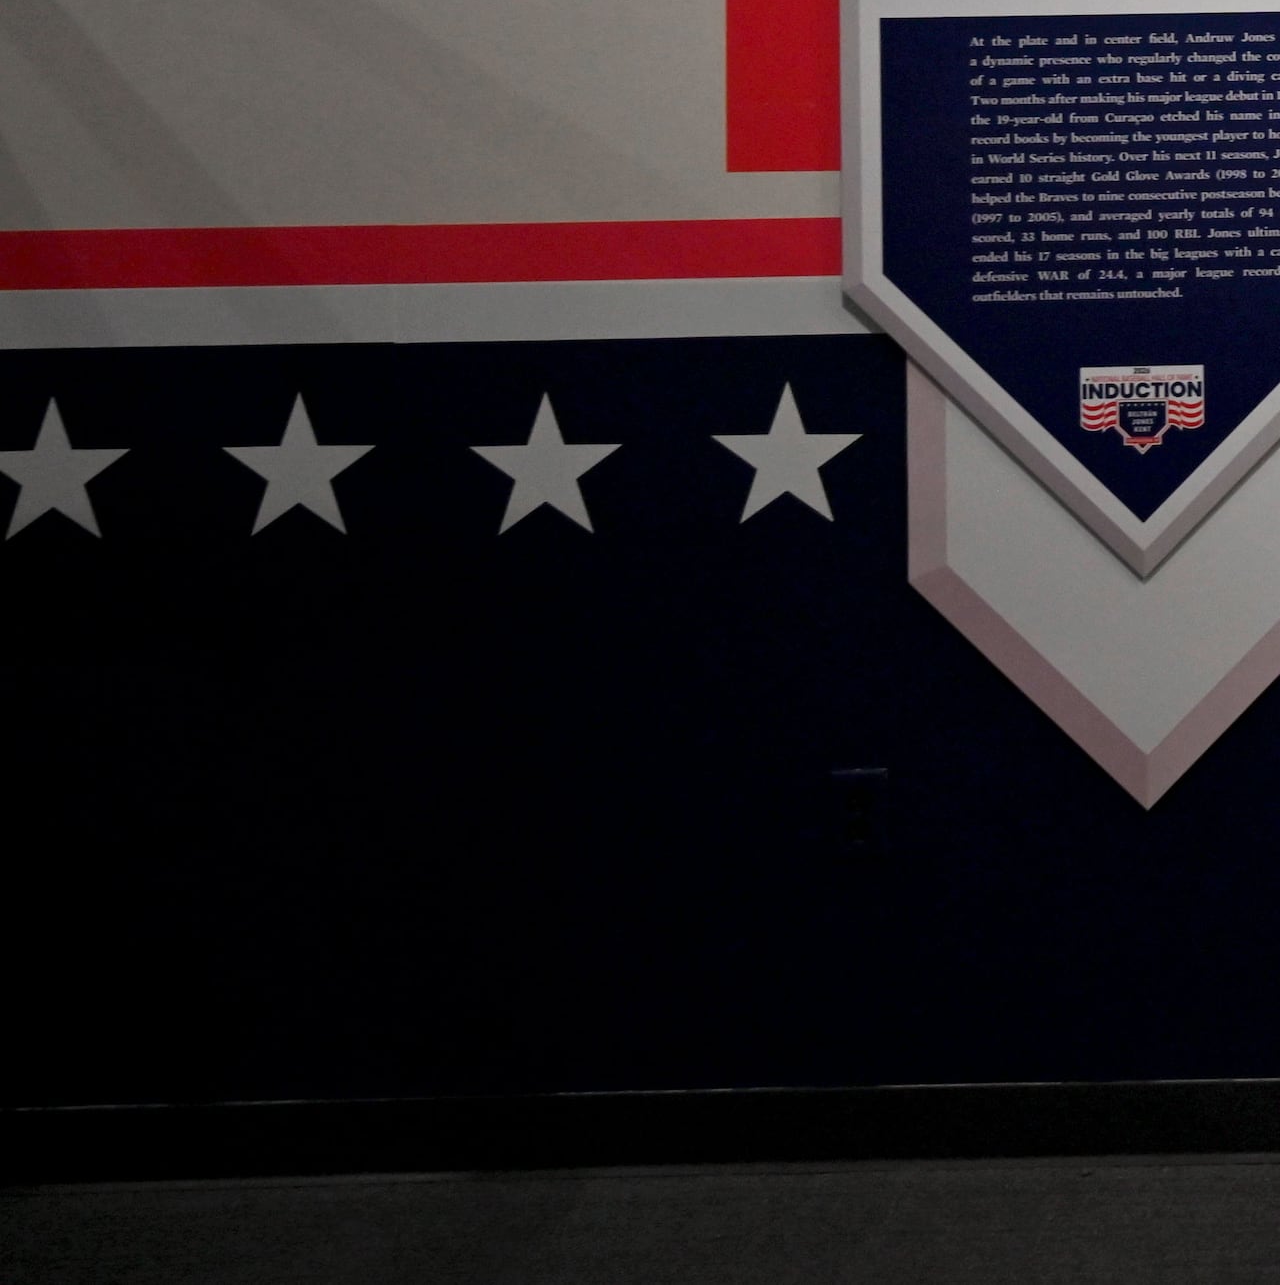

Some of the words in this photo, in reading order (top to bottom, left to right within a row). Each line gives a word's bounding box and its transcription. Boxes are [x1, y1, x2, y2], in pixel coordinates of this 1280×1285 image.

[970, 37, 984, 46] At
[991, 35, 1011, 46] the
[1018, 34, 1048, 48] plate
[1055, 34, 1077, 45] and
[1103, 35, 1142, 44] center
[1148, 32, 1178, 44] field,
[1185, 31, 1234, 43] Andruw
[1240, 31, 1275, 42] Jones
[970, 58, 976, 66] a
[982, 54, 1034, 66] dynamic
[1039, 57, 1092, 68] presence
[1096, 53, 1122, 64] who
[1128, 52, 1182, 66] regularly
[1186, 51, 1236, 65] changed
[1241, 50, 1261, 61] the
[970, 74, 984, 85] of
[1003, 77, 1035, 90] game
[1042, 73, 1070, 84] with
[1076, 76, 1091, 84] an
[1098, 75, 1130, 83] extra
[1136, 71, 1163, 83] base
[1170, 71, 1186, 82] hit
[1193, 74, 1207, 82] or
[1226, 70, 1265, 84] diving
[970, 95, 998, 105] Two
[1000, 93, 1046, 105] months
[1048, 92, 1078, 104] after
[1080, 92, 1125, 106] making
[1127, 91, 1145, 102] his
[1147, 94, 1182, 107] major
[1184, 90, 1223, 104] league
[1224, 89, 1259, 101] debut
[1261, 92, 1274, 100] in
[970, 114, 990, 125] the
[1069, 112, 1098, 123] from
[1160, 110, 1200, 121] etched
[1206, 109, 1224, 120] his
[1230, 112, 1262, 120] name
[971, 133, 1010, 144] record
[1014, 132, 1049, 143] books
[1052, 132, 1067, 145] by
[1070, 131, 1129, 145] becoming
[1132, 130, 1152, 141] the
[1155, 132, 1208, 146] youngest
[1212, 129, 1249, 143] player
[1252, 131, 1265, 139] to
[971, 156, 983, 164] in
[987, 152, 1025, 163] World
[1028, 152, 1066, 163] Series
[1069, 151, 1115, 164] history.
[1118, 151, 1149, 161] Over
[1152, 150, 1170, 160] his
[1174, 152, 1201, 160] next
[1220, 151, 1269, 160] seasons,
[970, 172, 1012, 184] earned
[1019, 173, 1032, 182] 10
[1038, 171, 1085, 185] straight
[1090, 170, 1120, 181] Gold
[1125, 169, 1159, 181] Glove
[1164, 168, 1210, 180] Awards
[1252, 170, 1265, 178] to
[972, 192, 1011, 206] helped
[1015, 191, 1035, 202] the
[1038, 192, 1078, 202] Braves
[1082, 193, 1094, 201] to
[1098, 193, 1124, 201] nine
[1127, 188, 1197, 200] consecutive
[1200, 189, 1265, 201] postseason
[1008, 214, 1021, 222] to
[1070, 210, 1092, 221] and
[1098, 209, 1152, 223] averaged
[1158, 208, 1195, 222] yearly
[1200, 207, 1234, 218] totals
[1240, 206, 1254, 218] of
[1258, 207, 1273, 217] 94
[972, 231, 1014, 243] scored,
[1021, 232, 1034, 241] 33
[1041, 230, 1074, 241] home
[1080, 232, 1112, 241] runs,
[1118, 228, 1140, 240] and
[1147, 229, 1168, 239] 100
[1207, 227, 1241, 238] Jones
[972, 250, 1008, 262] ended
[1014, 250, 1032, 261] his
[1038, 251, 1050, 261] 17
[1055, 252, 1101, 261] seasons
[1124, 248, 1144, 259] the
[1150, 247, 1168, 261] big
[1174, 247, 1218, 260] leagues
[1224, 246, 1252, 257] with
[972, 270, 1028, 282] defensive
[1037, 270, 1069, 280] WAR
[1077, 268, 1091, 279] of
[1152, 270, 1187, 283] major
[1195, 266, 1234, 280] league
[972, 289, 1036, 302] outfielders
[1039, 289, 1063, 300] that
[1066, 291, 1114, 299] remains
[1116, 286, 1183, 298] untouched.
[1082, 381, 1202, 399] INDUCTION
